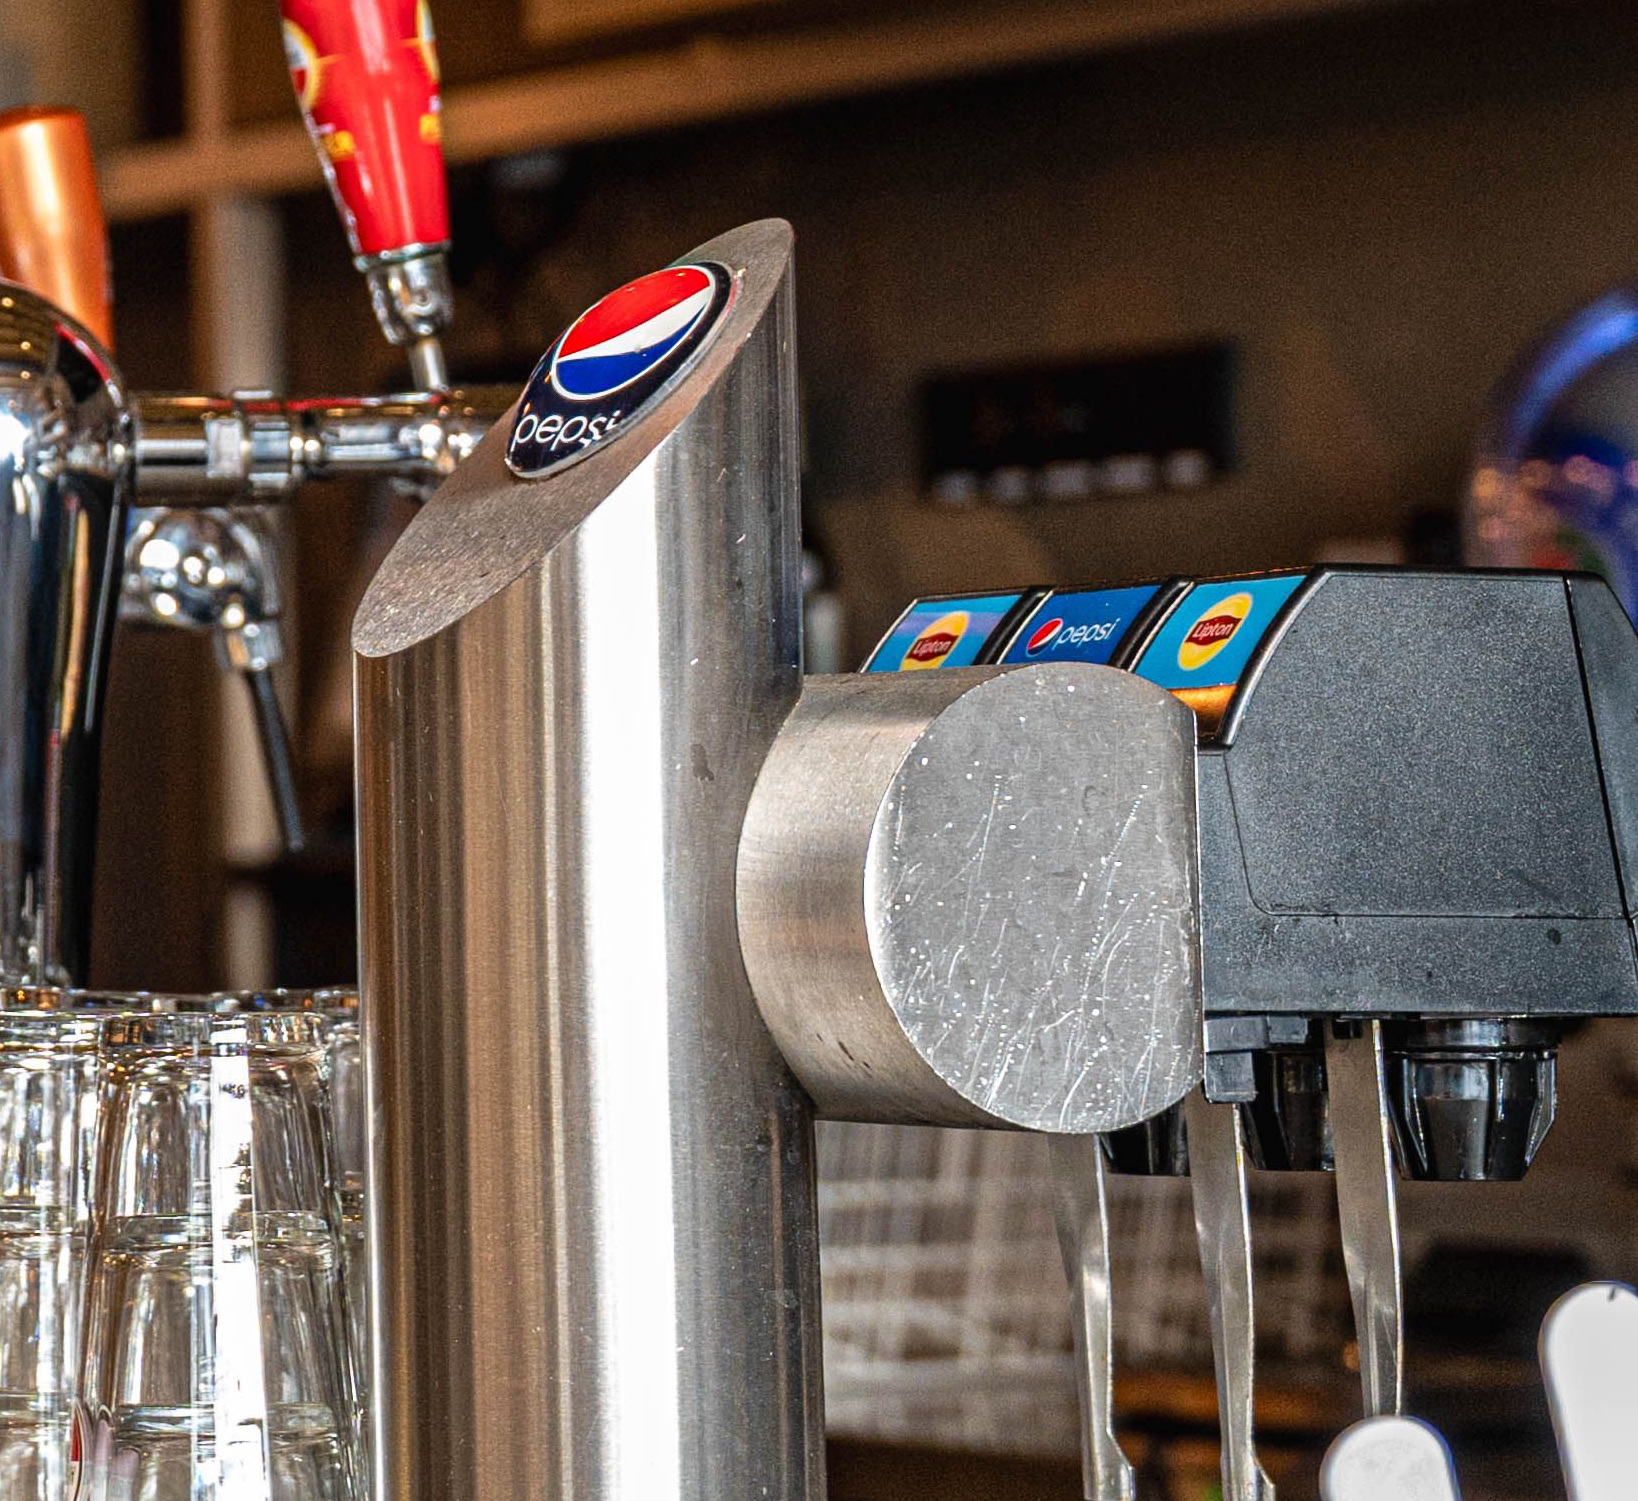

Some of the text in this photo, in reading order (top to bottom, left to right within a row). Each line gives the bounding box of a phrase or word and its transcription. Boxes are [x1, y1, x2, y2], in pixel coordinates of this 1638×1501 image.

[511, 410, 621, 452] pepsi
[1051, 617, 1121, 651] pepsi
[1192, 621, 1234, 640] Lipton
[913, 639, 952, 657] Lipton
